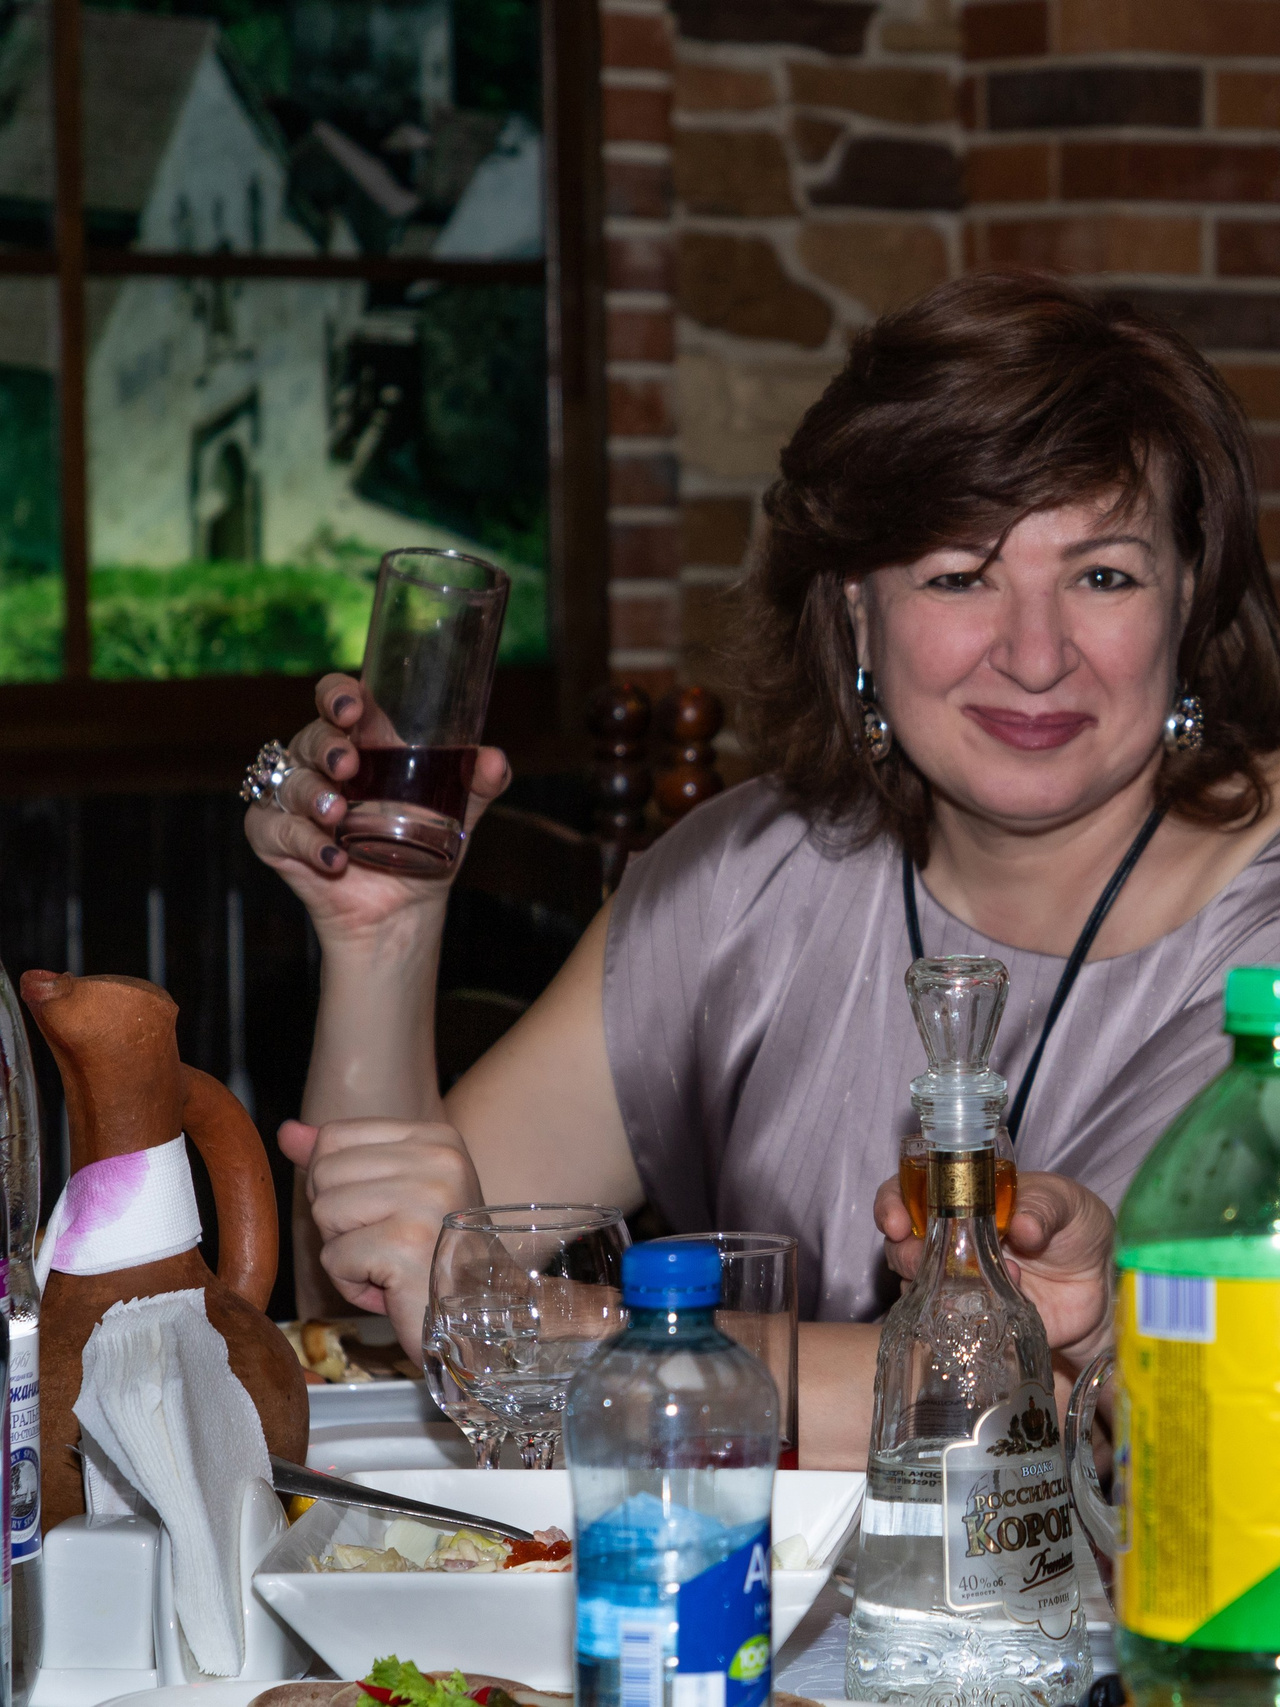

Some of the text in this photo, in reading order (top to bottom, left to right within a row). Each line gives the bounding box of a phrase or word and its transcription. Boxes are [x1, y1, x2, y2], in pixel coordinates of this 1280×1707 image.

[962, 1503, 1073, 1557] КОРОН
[962, 1588, 996, 1600] крепость
[1038, 1592, 1070, 1609] ГРАФИН
